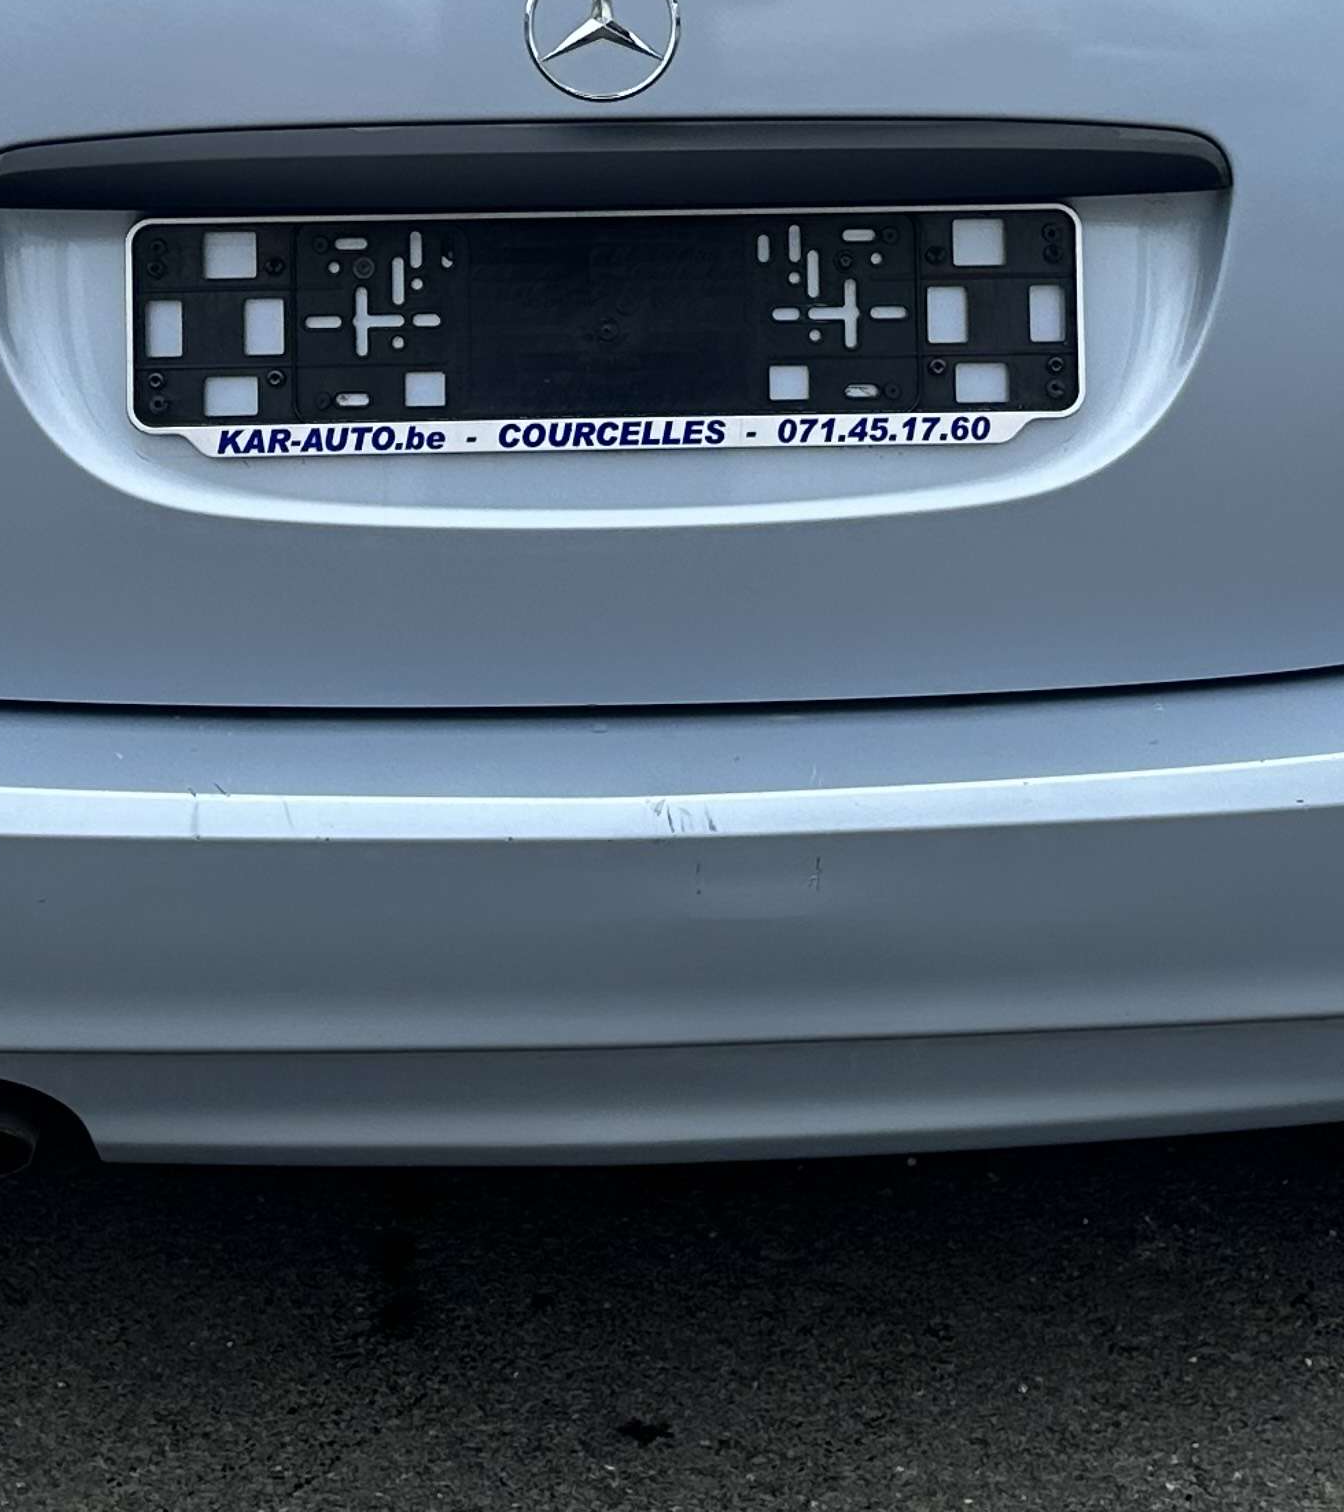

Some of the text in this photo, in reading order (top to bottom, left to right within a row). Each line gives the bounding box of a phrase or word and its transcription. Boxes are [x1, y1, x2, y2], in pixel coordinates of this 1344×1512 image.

[217, 425, 446, 454] KAR-AUTO.be
[498, 419, 726, 449] COURCELLES
[777, 416, 991, 444] 071.45.17.60
